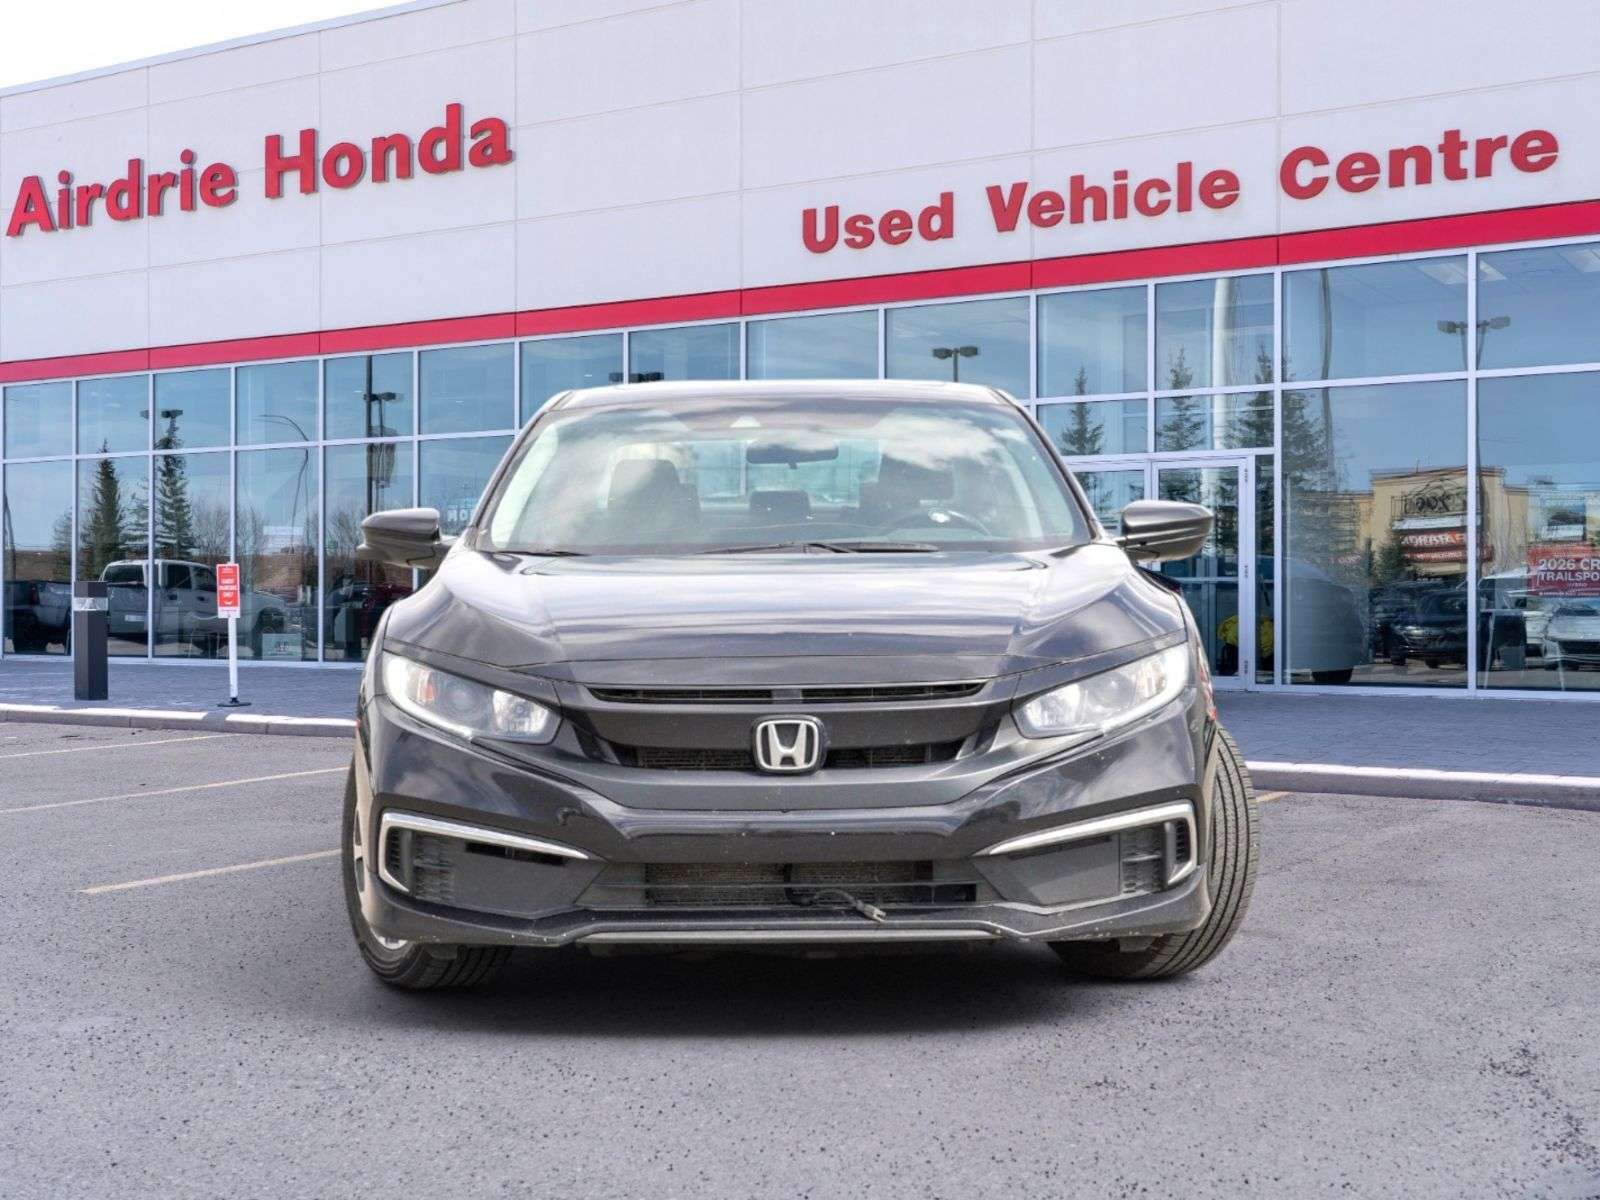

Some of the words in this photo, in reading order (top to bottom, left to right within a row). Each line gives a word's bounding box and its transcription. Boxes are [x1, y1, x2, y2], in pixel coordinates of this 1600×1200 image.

[7, 149, 236, 237] Airdrie
[265, 103, 512, 199] Honda
[802, 191, 954, 253] Used
[986, 162, 1240, 232] Vehicle
[1280, 129, 1559, 200] Centre
[1539, 558, 1576, 571] 2026
